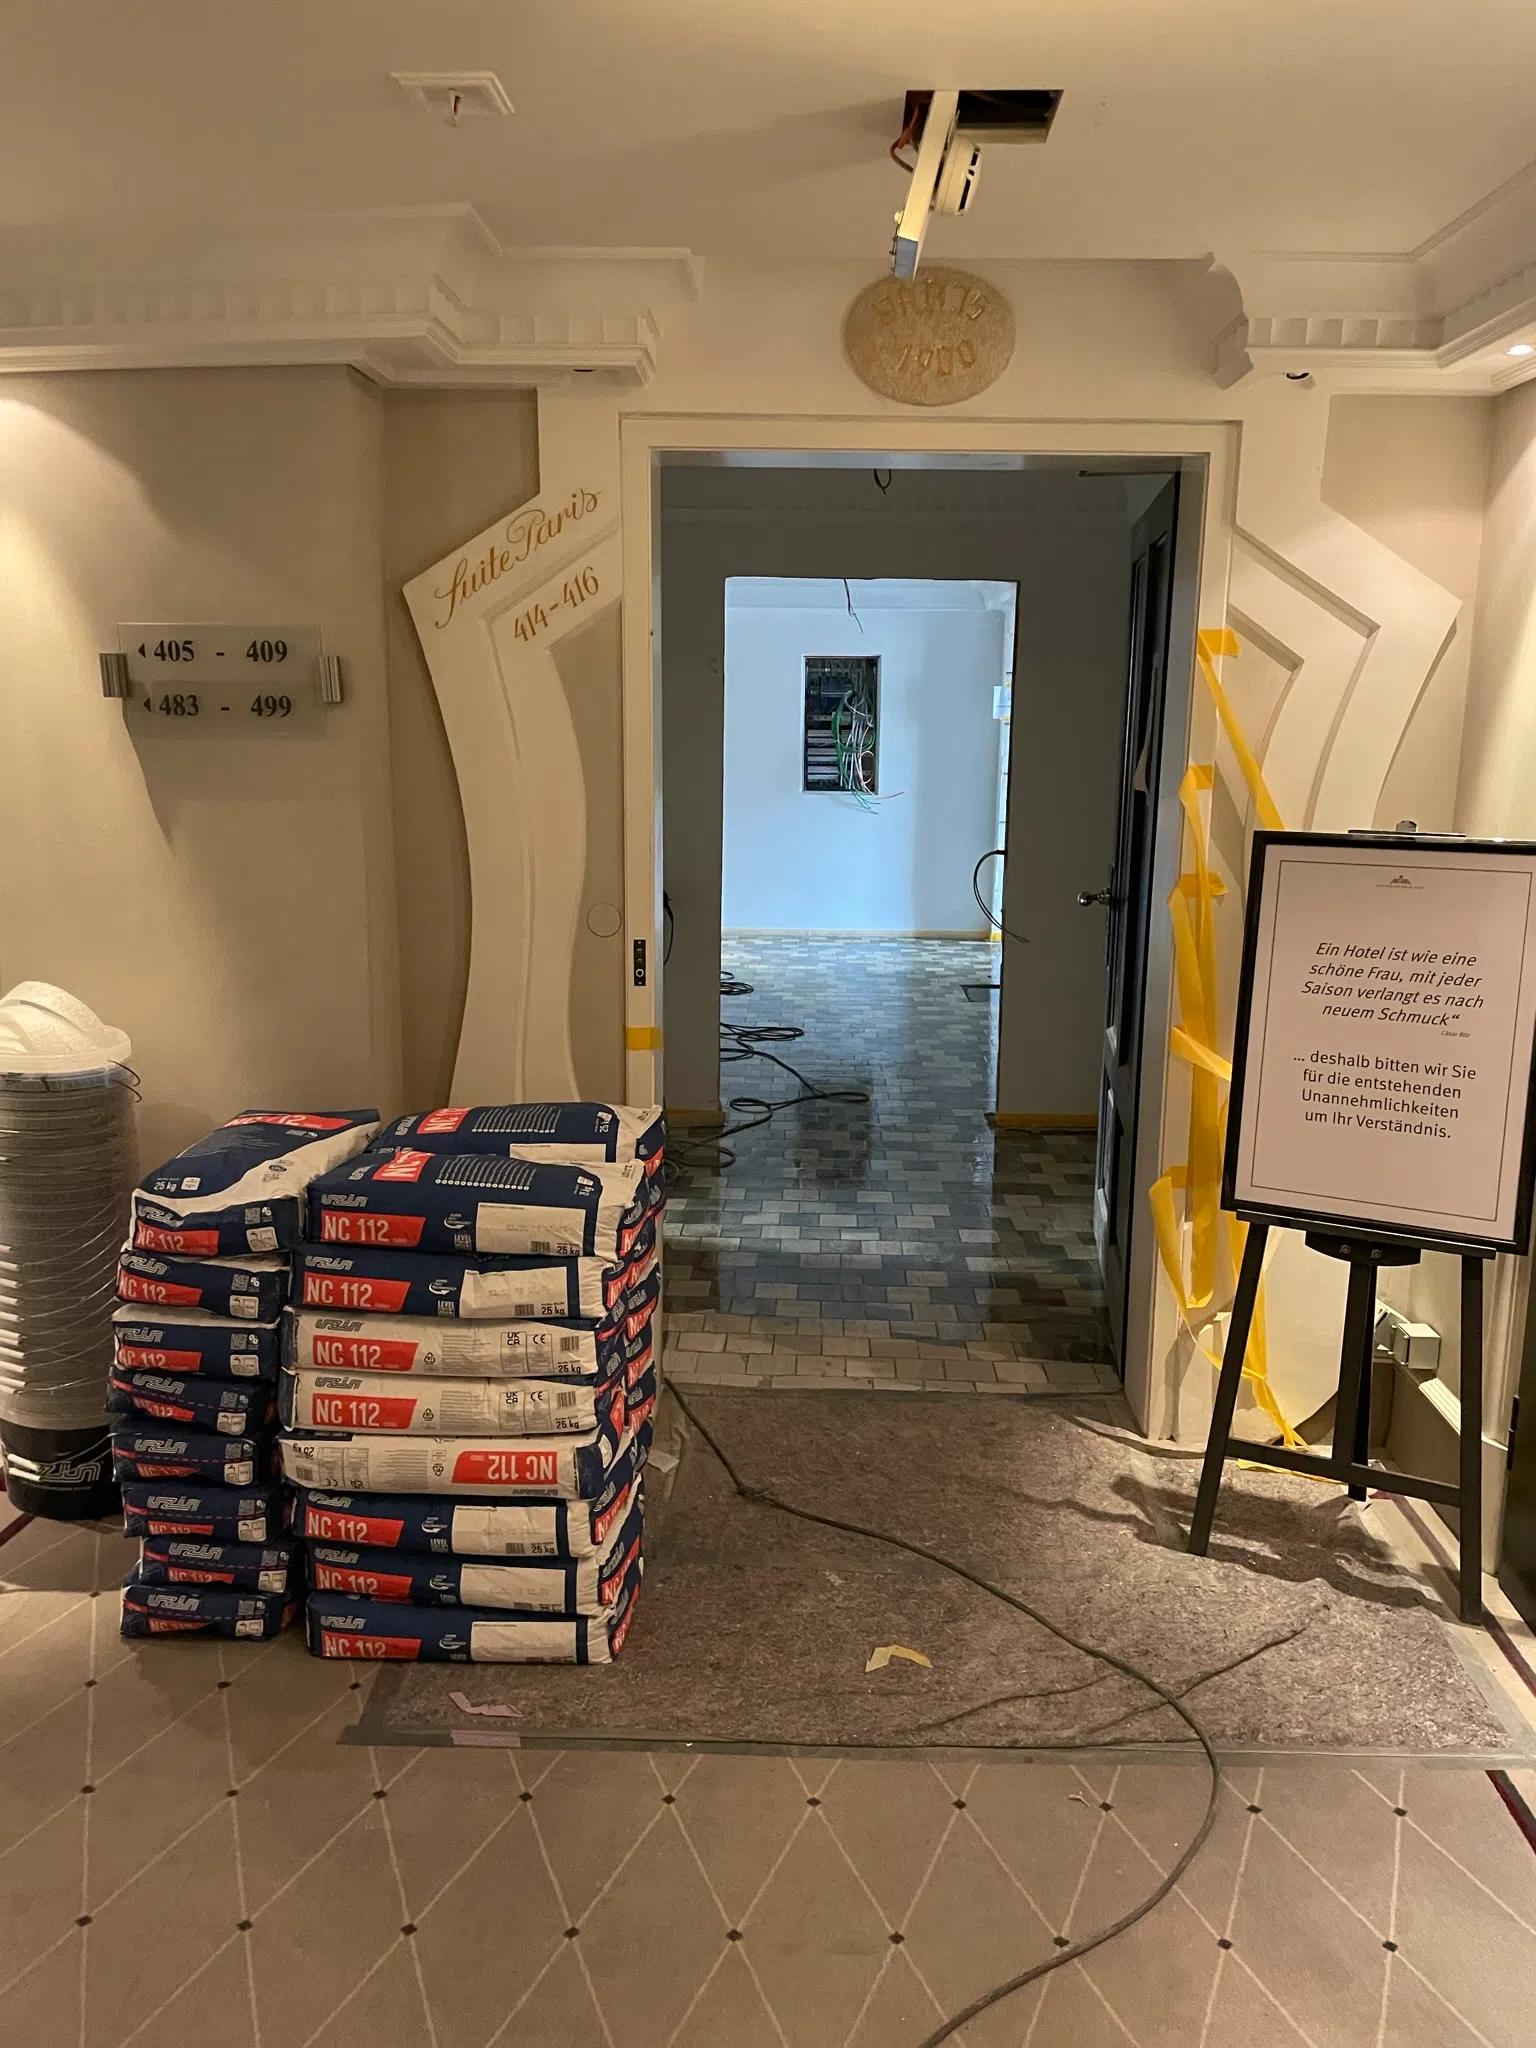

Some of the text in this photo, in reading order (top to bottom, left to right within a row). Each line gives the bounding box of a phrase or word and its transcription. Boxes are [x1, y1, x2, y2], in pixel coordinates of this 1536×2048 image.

[434, 488, 603, 629] Suite Paris
[154, 640, 195, 662] 405
[246, 640, 288, 662] 409
[159, 694, 199, 716] 483
[250, 695, 292, 717] 499
[1315, 942, 1477, 967] Ein Hotel ist wie eine
[1308, 962, 1483, 988] schöne Frau, mit jeder
[1301, 980, 1484, 1009] Saison verlangt es nach
[1322, 1005, 1375, 1019] neuem
[1310, 1049, 1370, 1069] deshalb
[1374, 1056, 1419, 1074] bitten
[1424, 1062, 1449, 1077] wir
[1451, 1064, 1477, 1080] Sie
[1303, 1068, 1461, 1099] für die entstehenden
[1302, 1089, 1460, 1118] Unannehmlichkeiten
[1305, 1111, 1452, 1139] um Ihr Verständnis.
[324, 1215, 390, 1242] NC 112
[160, 1233, 185, 1251] 112
[557, 1246, 568, 1255] 25
[119, 1278, 167, 1302] NC 112
[306, 1277, 373, 1307] NC 112
[541, 1306, 565, 1315] 25 kg
[317, 1340, 382, 1367] NC 112
[558, 1364, 581, 1374] 25 kg
[316, 1399, 380, 1427] NC 112
[556, 1420, 580, 1429] 25 kg
[487, 1455, 553, 1480] NC 112
[309, 1512, 368, 1543] NC 112
[531, 1545, 555, 1554] 25 kg
[318, 1569, 380, 1594] NC 112
[324, 1635, 386, 1657] NC 112
